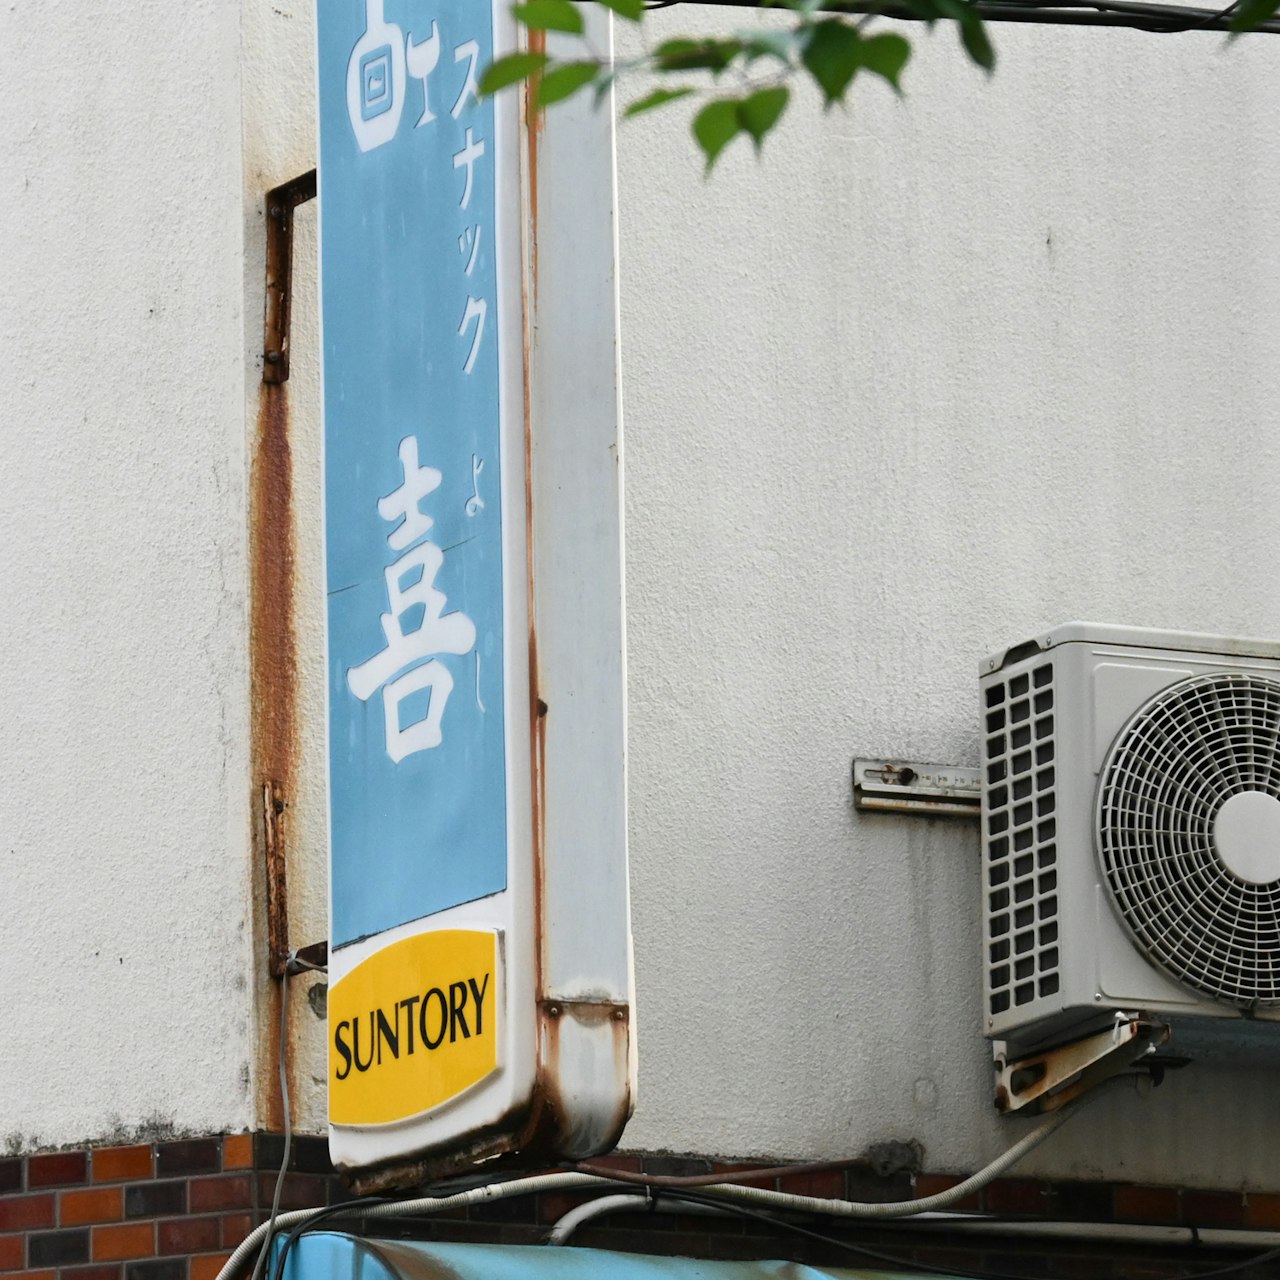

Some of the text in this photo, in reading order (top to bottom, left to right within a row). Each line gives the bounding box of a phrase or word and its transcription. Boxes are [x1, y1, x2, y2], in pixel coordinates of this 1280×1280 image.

[450, 39, 487, 375] スナック
[346, 435, 477, 764] 喜
[334, 973, 490, 1080] SUNTORY
